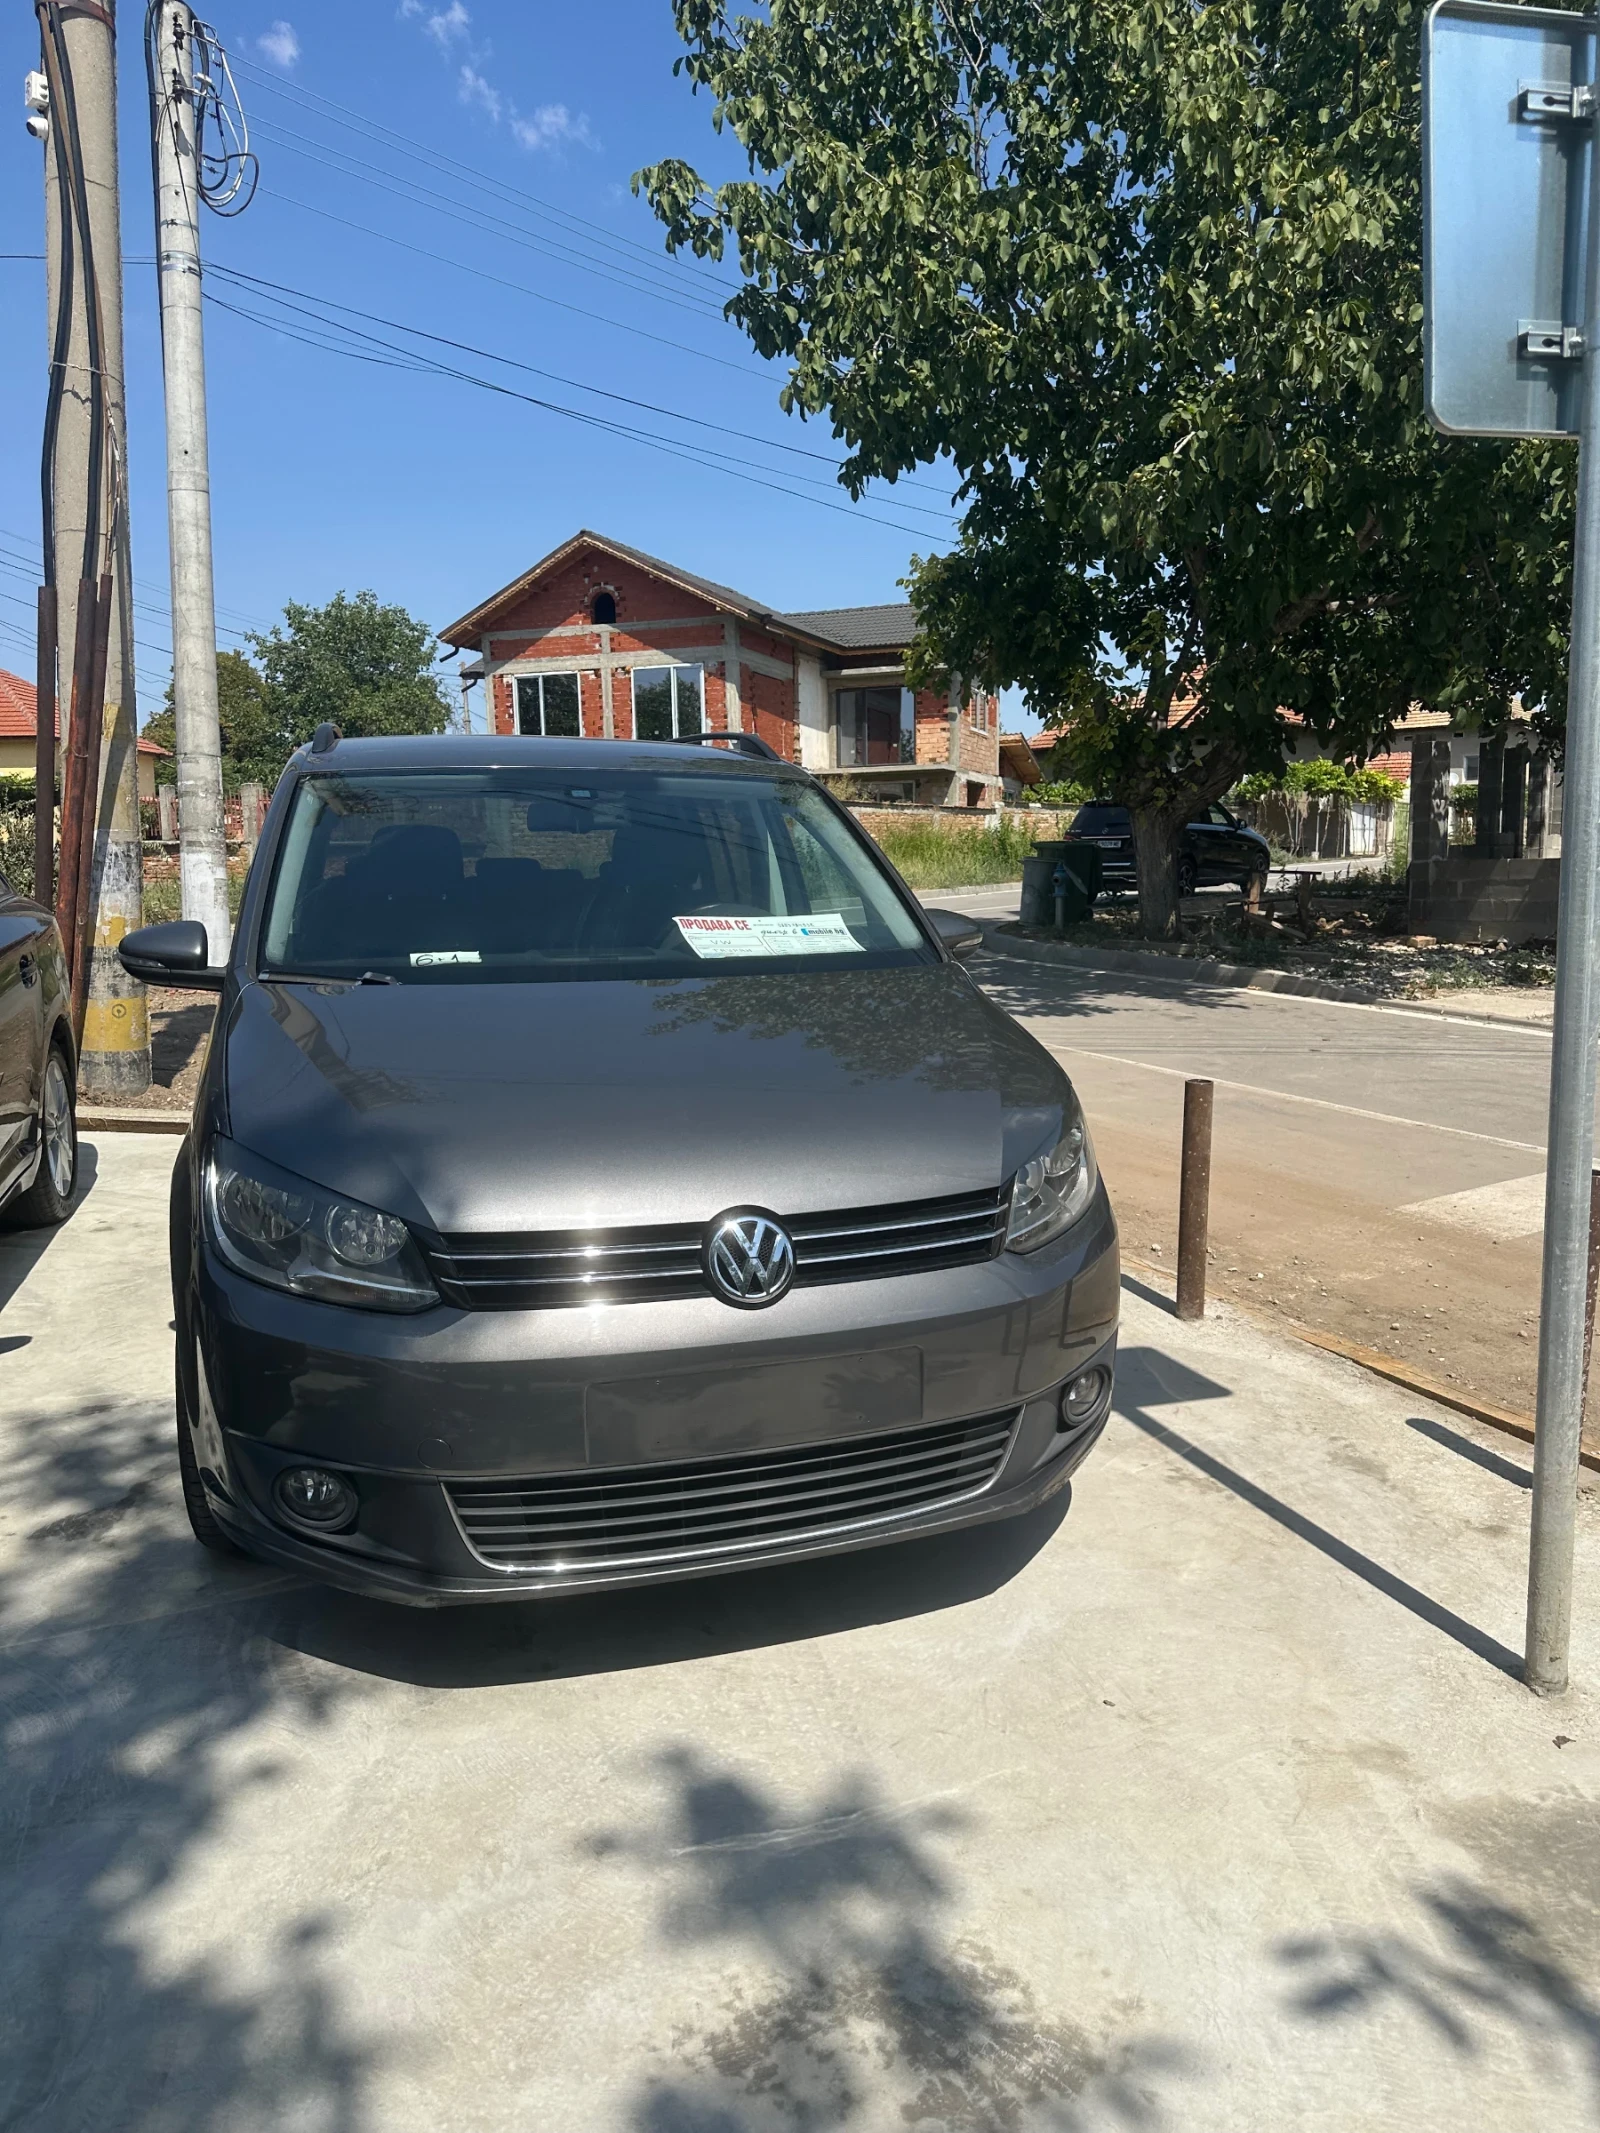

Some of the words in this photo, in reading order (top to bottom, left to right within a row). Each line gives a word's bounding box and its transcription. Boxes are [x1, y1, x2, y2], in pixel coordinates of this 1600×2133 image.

[678, 918, 735, 932] ПРОДАВА
[734, 919, 752, 931] СЕ
[709, 1215, 793, 1302] VW
